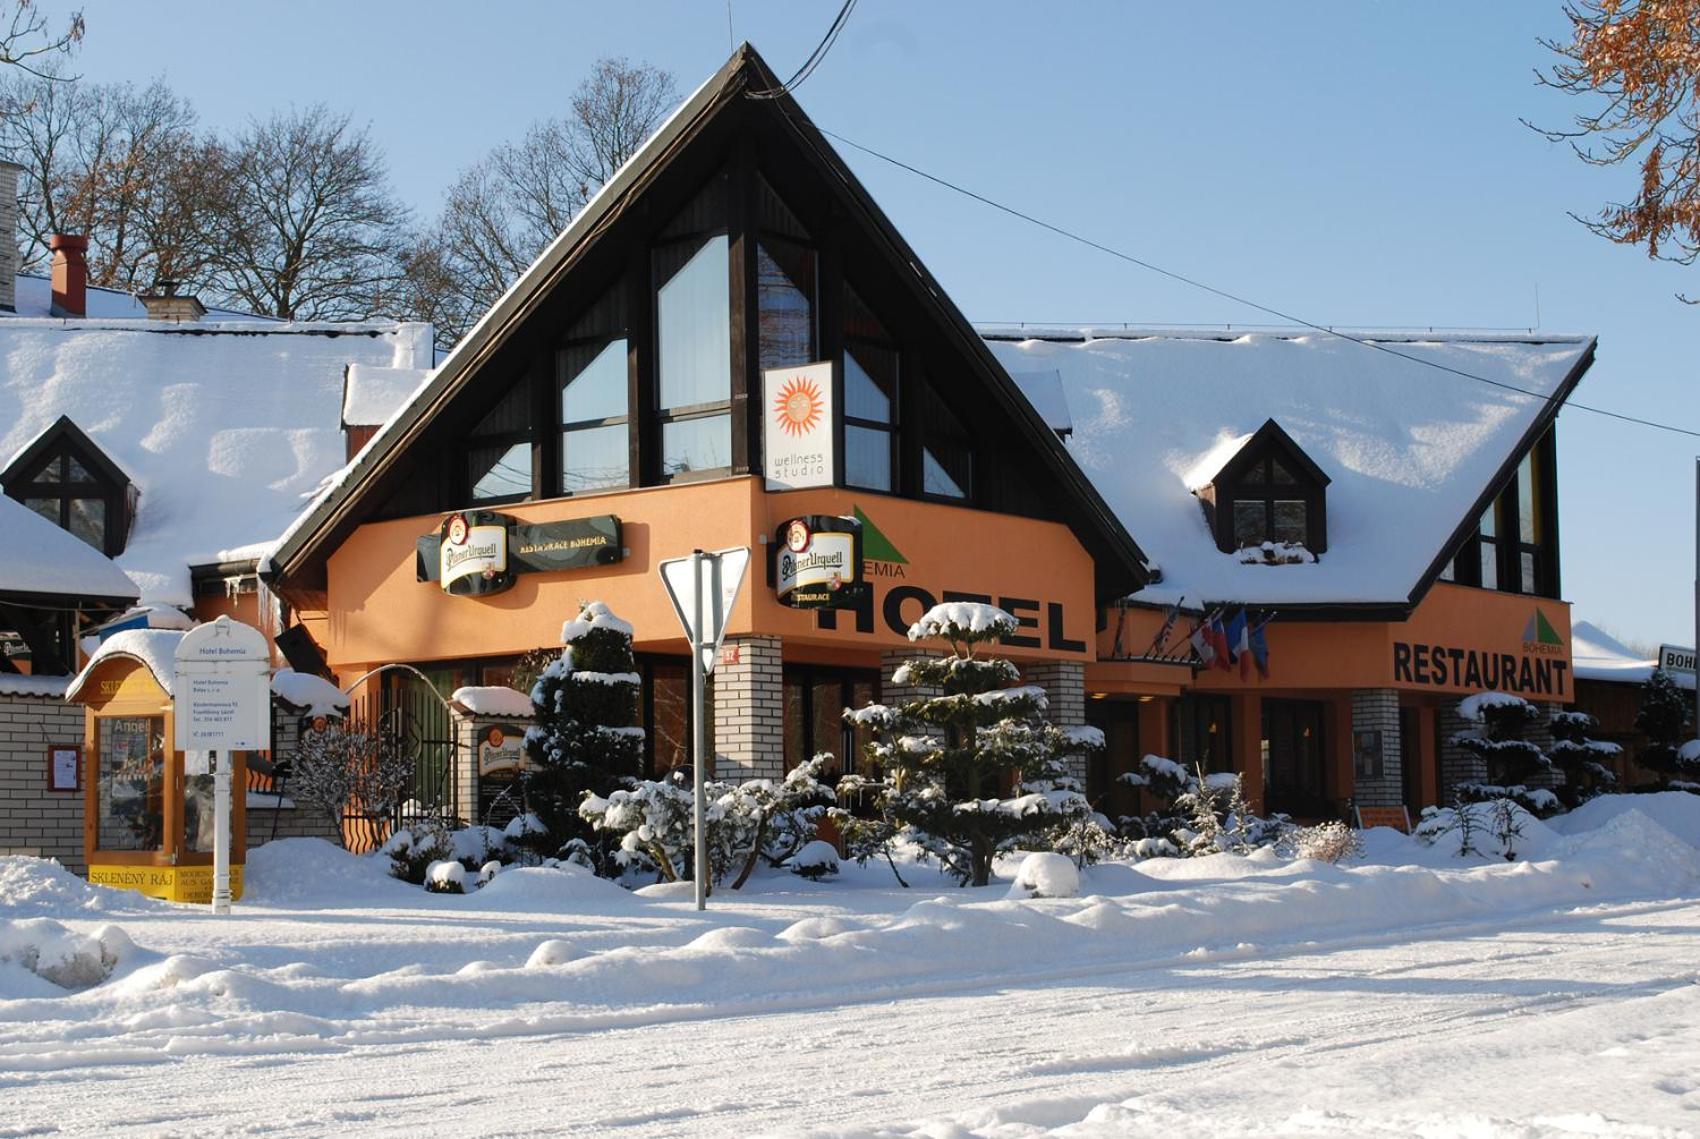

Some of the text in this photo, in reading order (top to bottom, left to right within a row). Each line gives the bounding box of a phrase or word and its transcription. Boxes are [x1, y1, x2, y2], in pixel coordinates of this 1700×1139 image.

[775, 454, 823, 466] wellness
[775, 465, 823, 478] studio
[570, 536, 607, 548] BOHEMIA
[467, 544, 496, 560] Urquell
[808, 551, 843, 569] Urquell
[863, 562, 906, 578] EMIA
[199, 647, 246, 655] Hotel Bohemia
[1523, 642, 1562, 655] BOHEMIA
[1393, 642, 1567, 696] RESTAURANT
